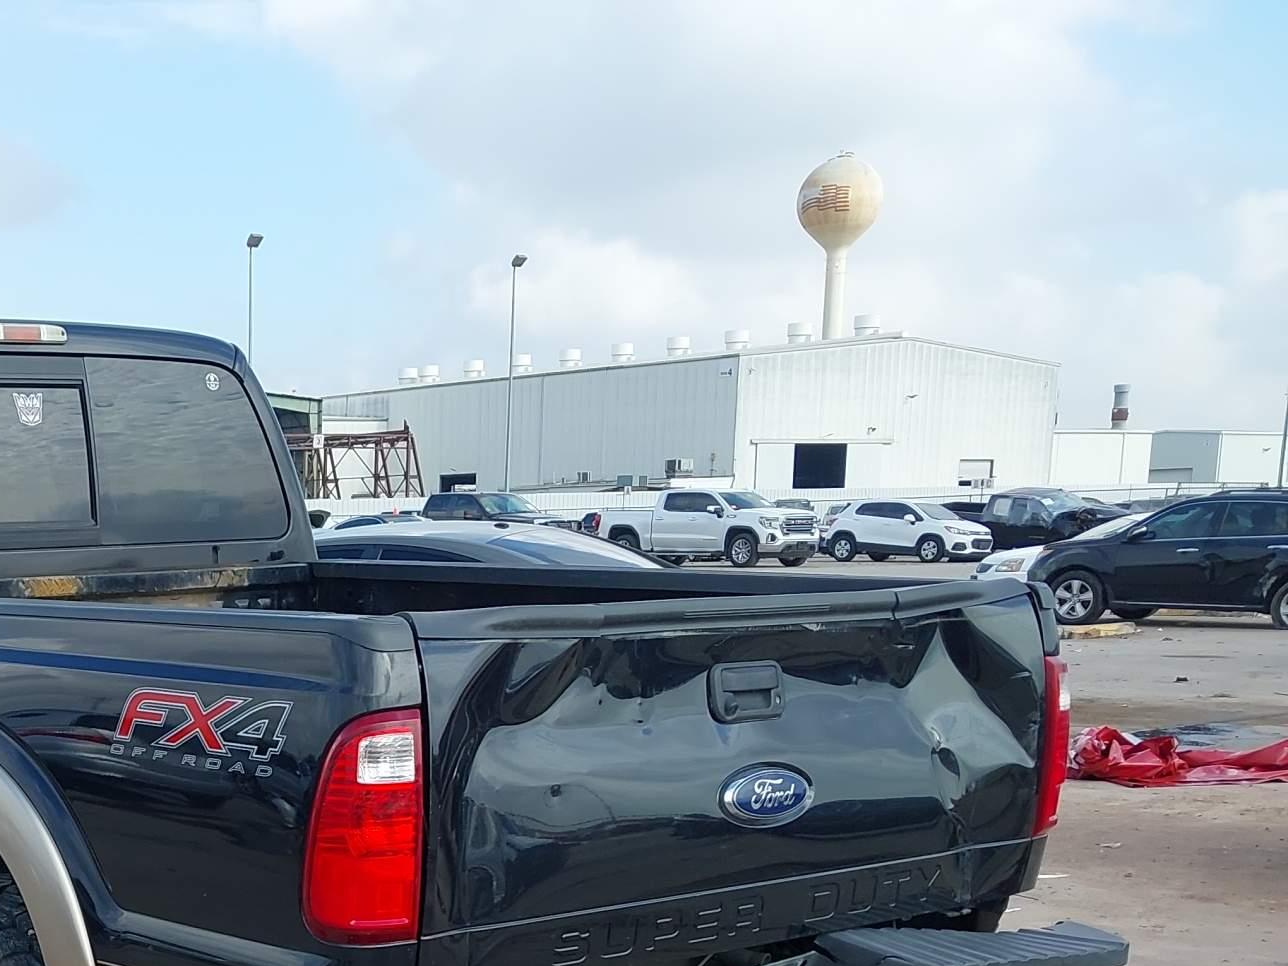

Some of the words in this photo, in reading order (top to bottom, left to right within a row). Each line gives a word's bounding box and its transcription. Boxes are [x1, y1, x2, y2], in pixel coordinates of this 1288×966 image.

[113, 686, 294, 762] FX4
[110, 743, 168, 761] OFF
[181, 754, 273, 778] ROAD
[750, 778, 796, 810] Ford
[804, 863, 943, 924] DUTY
